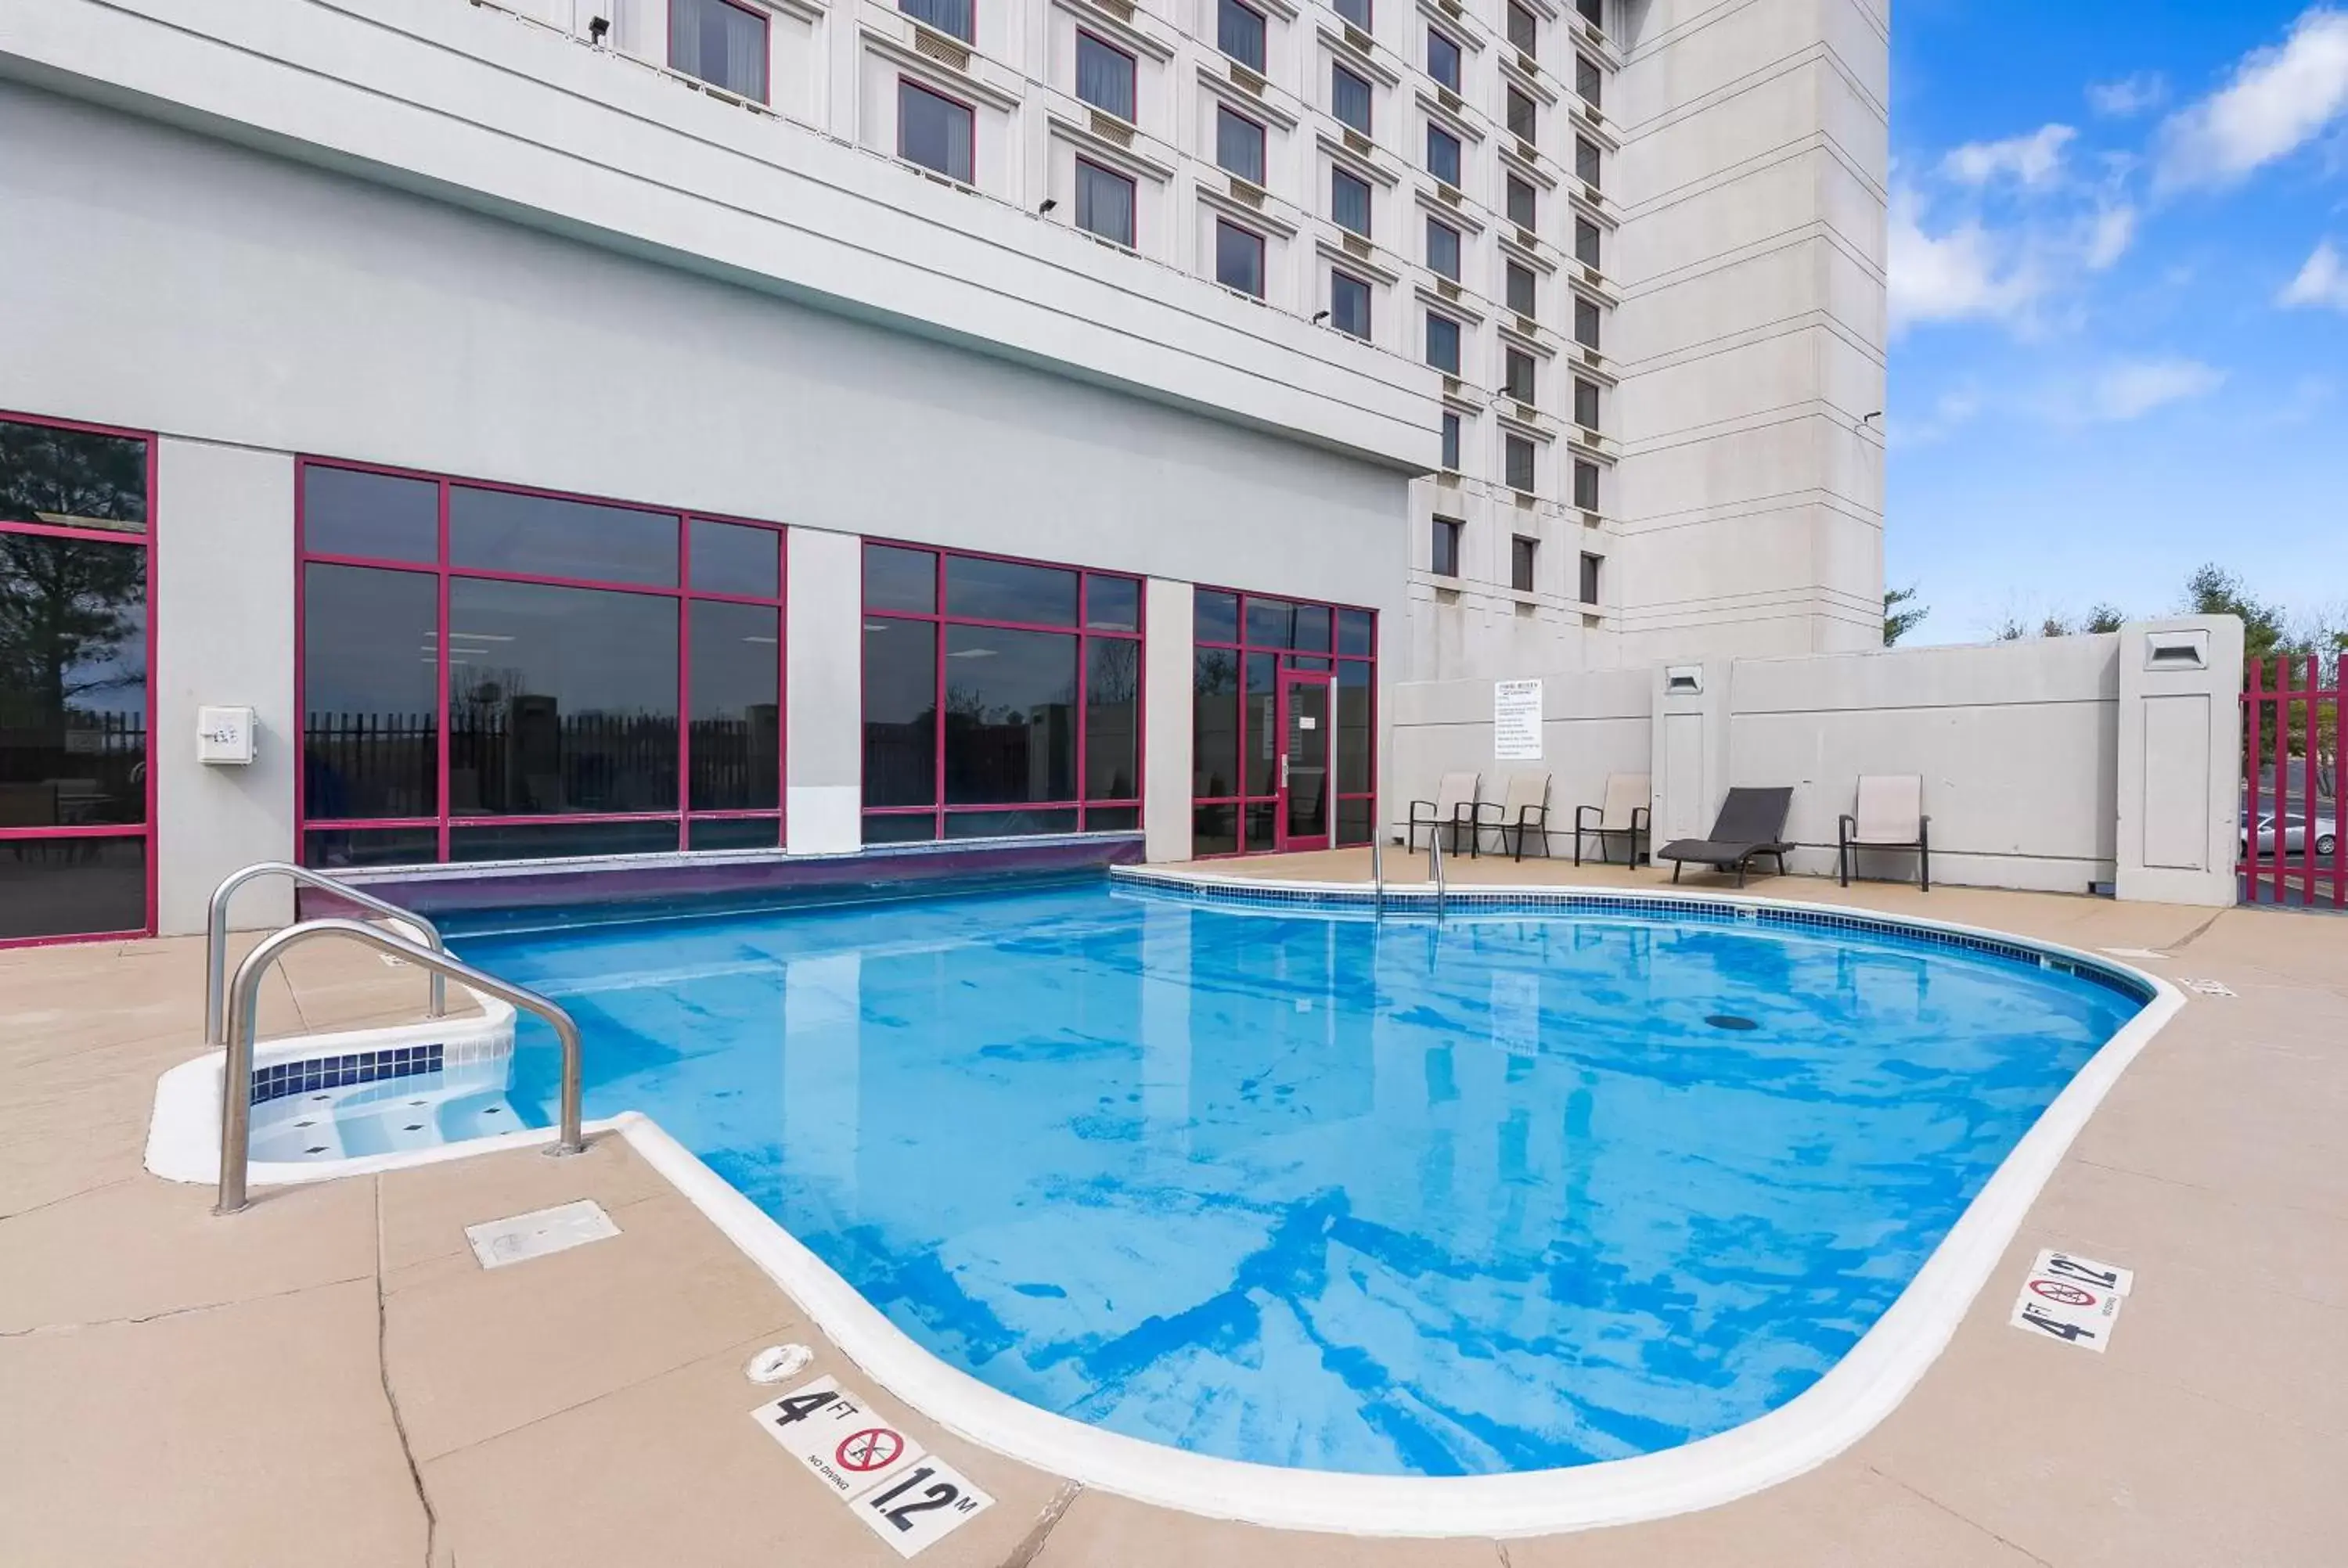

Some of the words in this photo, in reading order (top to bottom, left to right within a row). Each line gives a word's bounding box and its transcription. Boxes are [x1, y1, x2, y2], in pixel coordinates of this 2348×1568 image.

[2022, 1312, 2096, 1341] 4
[2026, 1302, 2052, 1318] FT
[776, 1390, 840, 1426] 4
[826, 1401, 859, 1420] FT
[808, 1455, 823, 1467] NO
[819, 1466, 850, 1491] DIVING
[870, 1467, 959, 1532] 1.2
[954, 1496, 978, 1514] M
